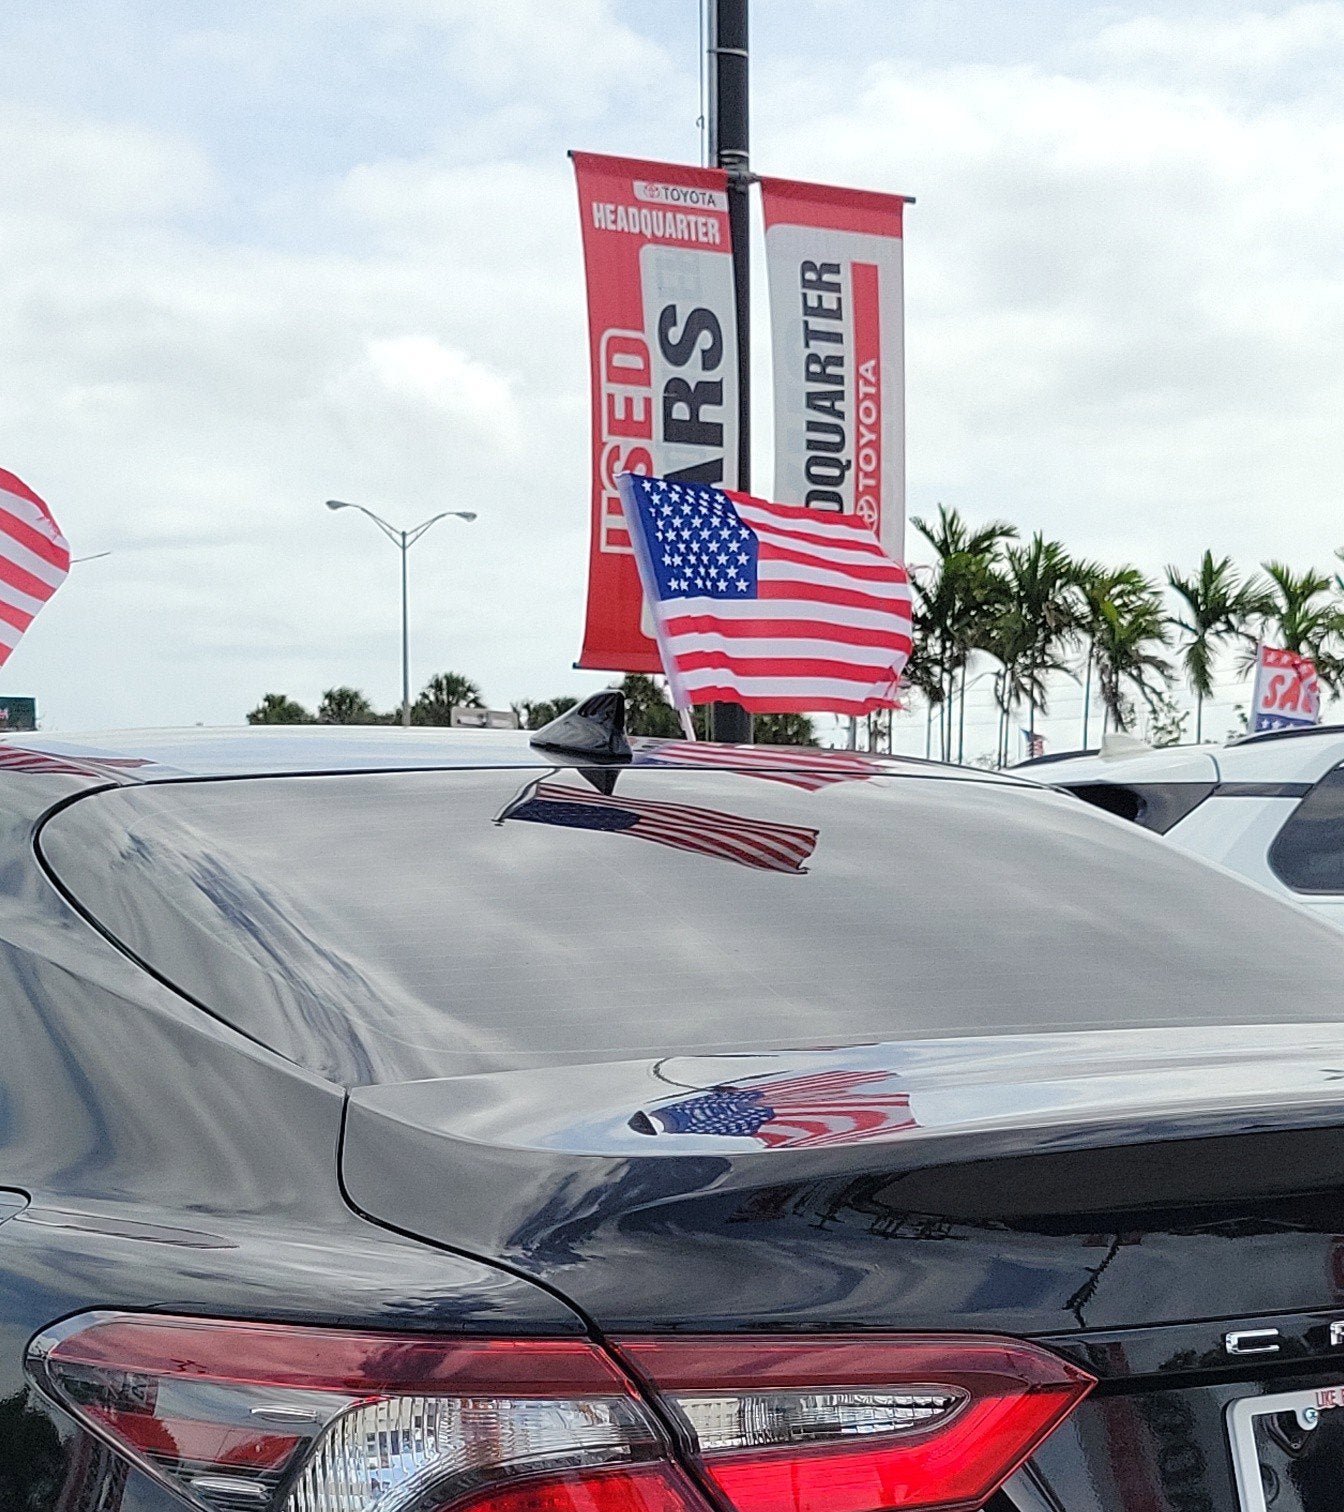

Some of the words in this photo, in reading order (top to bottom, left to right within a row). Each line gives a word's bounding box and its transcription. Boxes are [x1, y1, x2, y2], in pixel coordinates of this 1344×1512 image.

[592, 202, 721, 245] HEADQUARTER
[662, 187, 717, 207] TOYOTA
[658, 304, 724, 488] RS
[801, 259, 852, 514] DQUARTER
[857, 359, 877, 492] TOYOTA
[1315, 1390, 1336, 1408] LIKE
